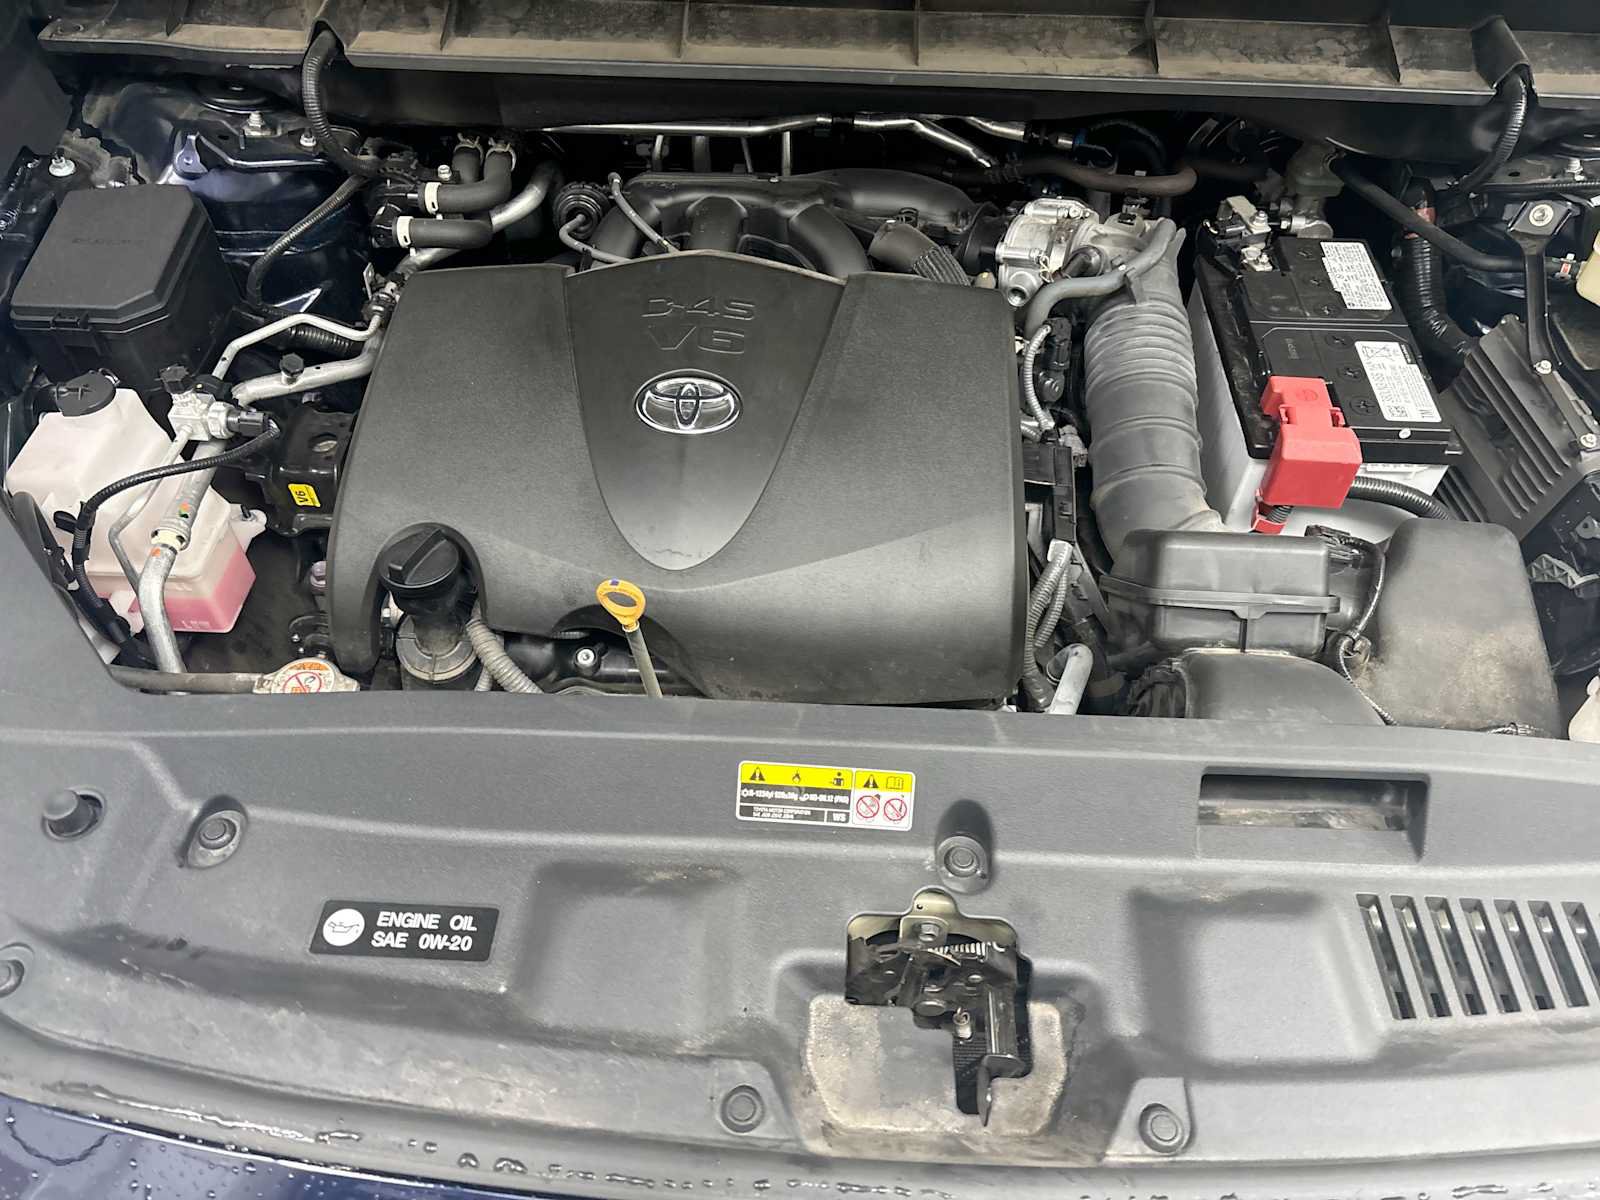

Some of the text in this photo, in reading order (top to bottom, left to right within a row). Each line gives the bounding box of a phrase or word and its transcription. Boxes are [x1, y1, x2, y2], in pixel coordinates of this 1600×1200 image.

[640, 298, 756, 321] D-4S
[646, 325, 746, 355] V6
[295, 490, 309, 503] V6
[832, 812, 846, 822] WS
[376, 911, 478, 932] ENGINE OIL
[370, 931, 473, 951] SAE 0W-20
